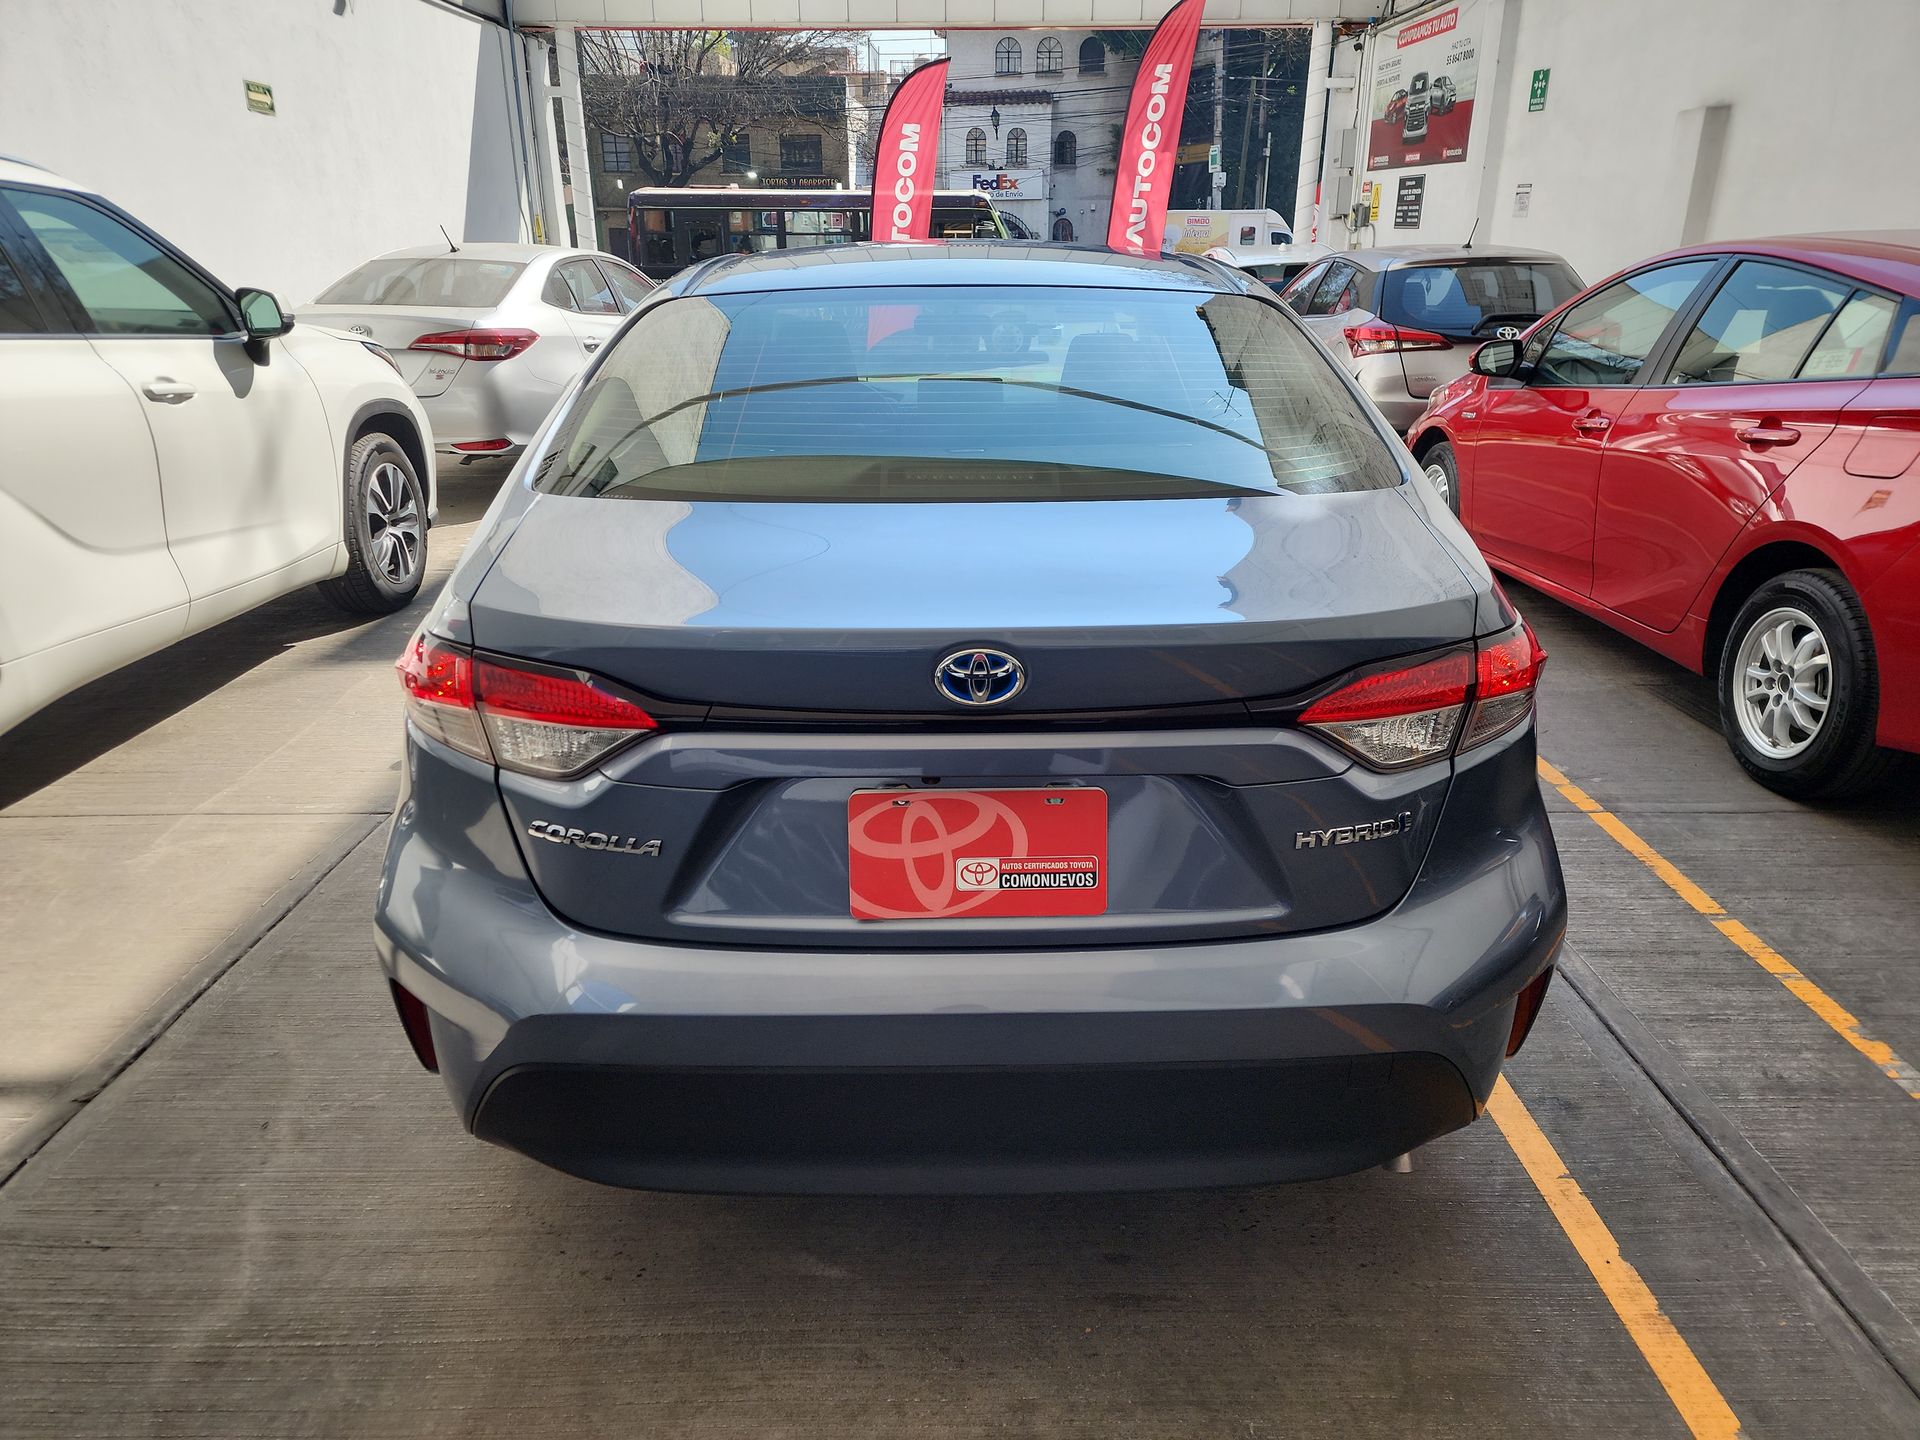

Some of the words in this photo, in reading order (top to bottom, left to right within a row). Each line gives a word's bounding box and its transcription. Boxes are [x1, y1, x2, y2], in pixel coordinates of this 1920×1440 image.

[1432, 18, 1441, 33] TU
[1440, 12, 1456, 31] AUTO
[1126, 63, 1173, 247] AUTOCOM
[761, 177, 788, 186] TORTAS
[973, 174, 1019, 190] FedEx
[528, 820, 662, 857] COROLLA
[1295, 819, 1399, 850] HYBRID
[1001, 862, 1023, 870] AUTOS
[1024, 861, 1068, 870] CERTIFICADOS
[1070, 861, 1094, 869] TOYOTA
[1001, 873, 1094, 888] COMONUEVOS
